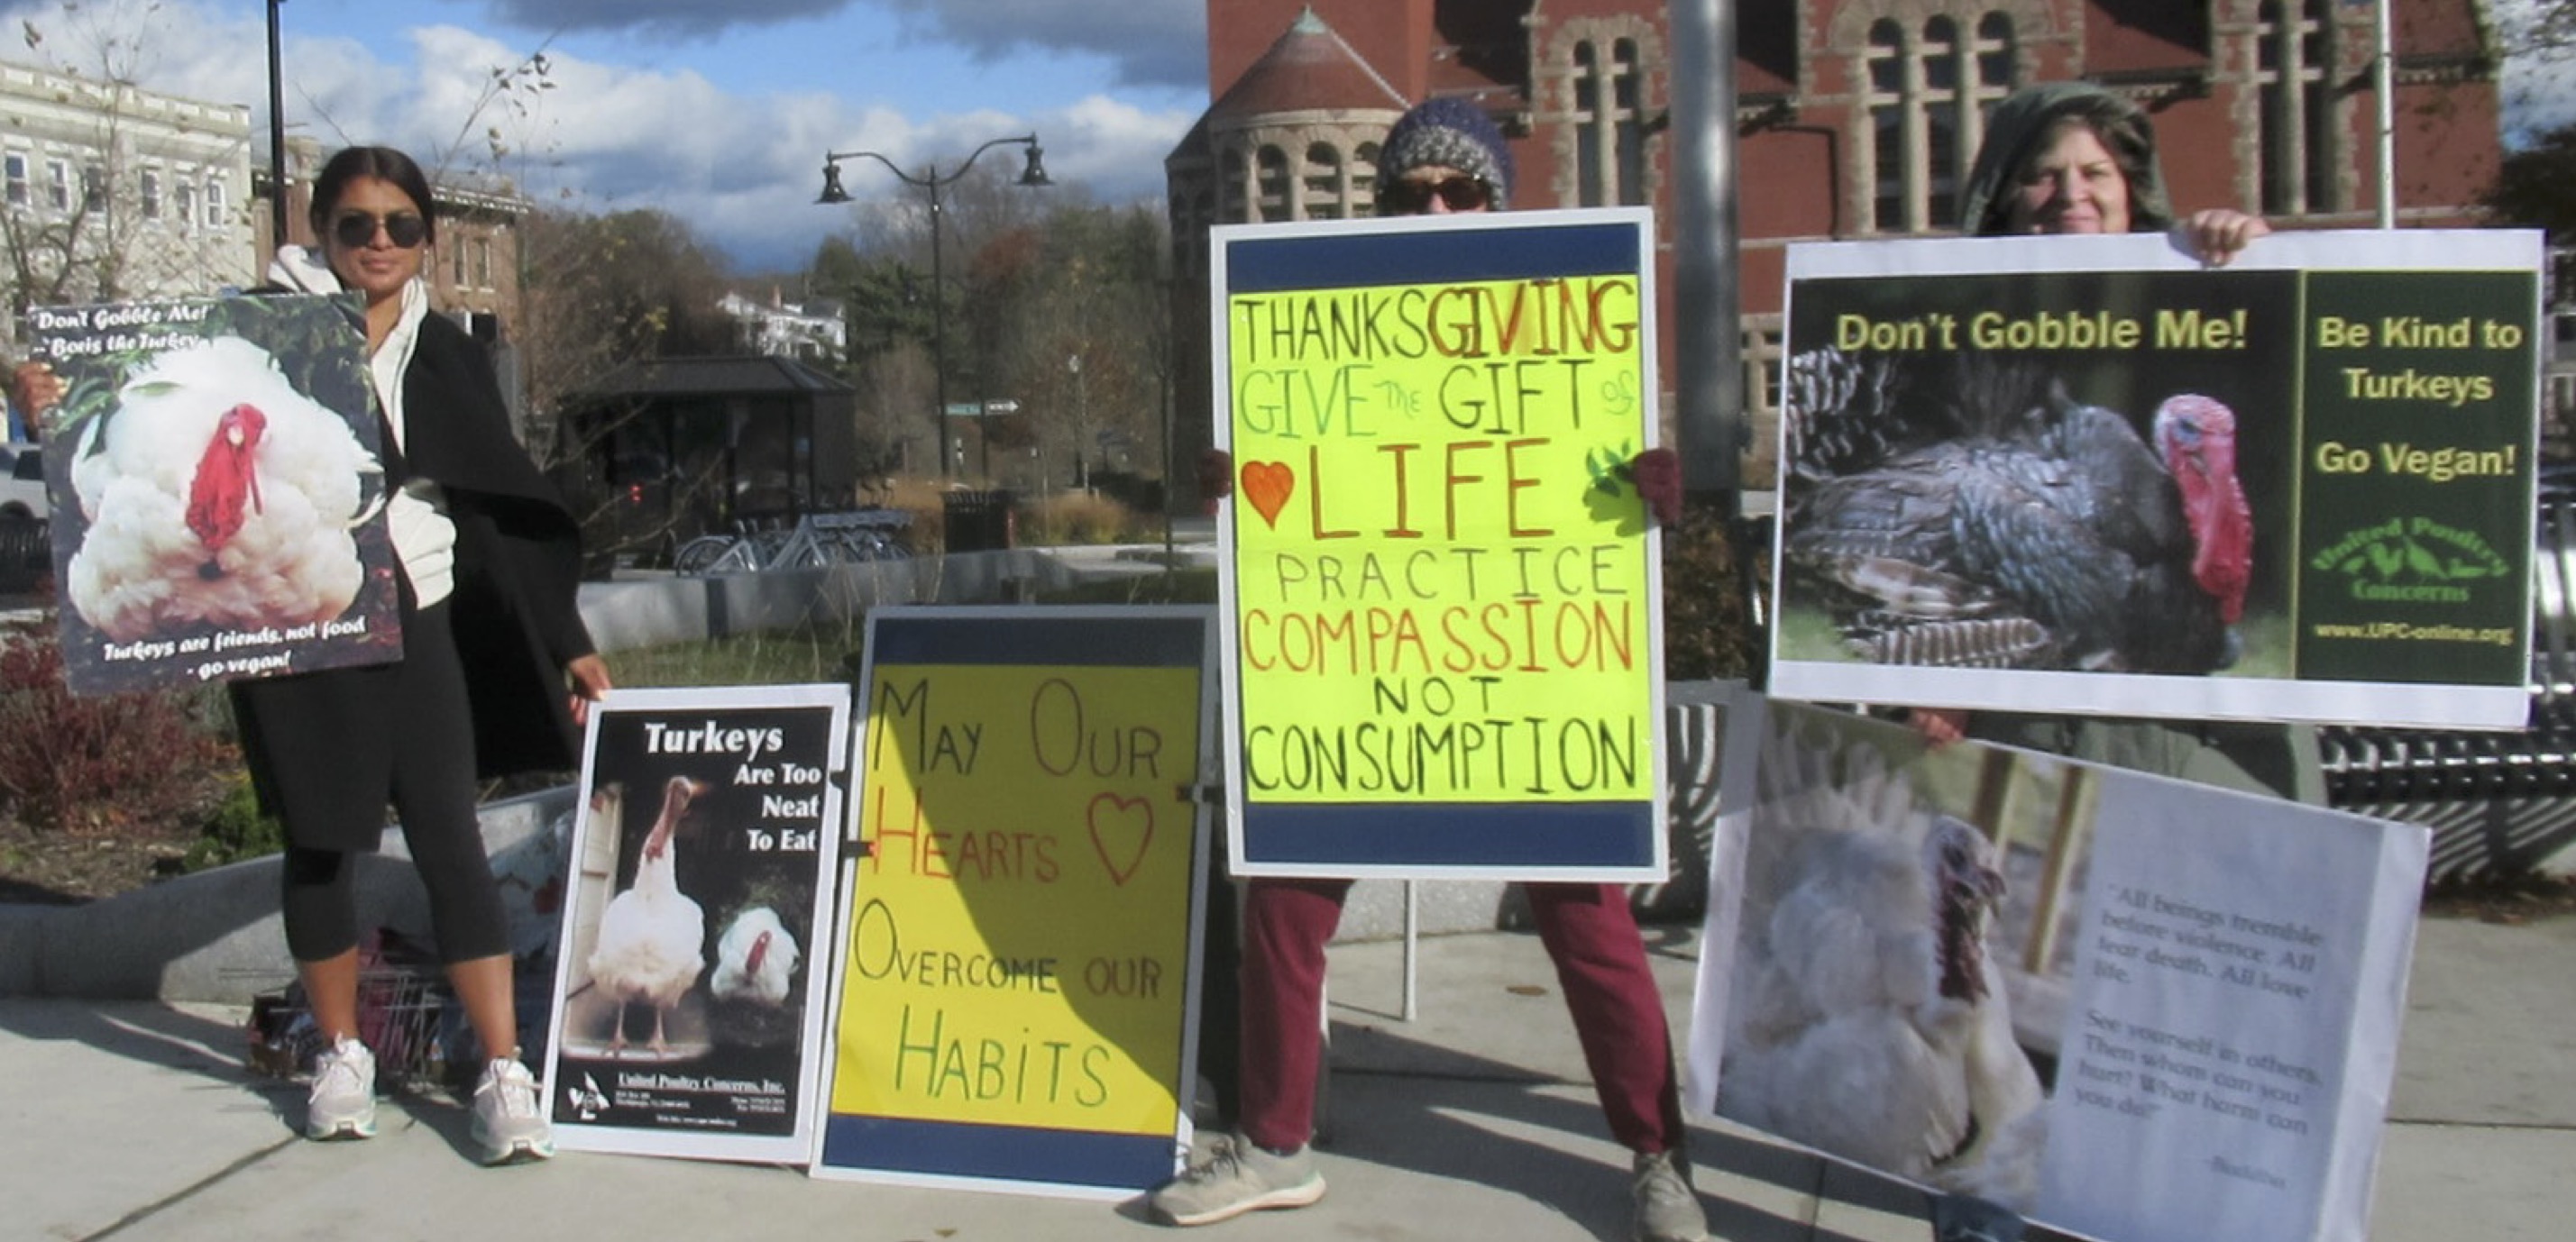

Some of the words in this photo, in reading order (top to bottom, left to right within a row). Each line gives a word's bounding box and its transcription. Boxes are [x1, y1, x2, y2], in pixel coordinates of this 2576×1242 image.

[94, 306, 163, 331] Gobble
[1233, 278, 1638, 363] THANKSGIVING
[1836, 313, 1957, 352] Don't
[1970, 310, 2141, 351] Gobble
[2155, 308, 2249, 350] Me!
[2317, 316, 2371, 348] Be
[2382, 316, 2471, 349] Kind
[2483, 319, 2523, 350] to
[106, 333, 137, 352] the
[1239, 364, 1378, 438] GIVE
[1438, 359, 1595, 435] GIFT
[2342, 367, 2495, 408] Turkeys
[2316, 441, 2372, 474] Go
[2380, 442, 2517, 482] Vegan!
[1308, 437, 1554, 541] LIFE
[2310, 516, 2403, 571] United
[2410, 516, 2510, 578] Poultry
[1275, 543, 1627, 601] PRACTICE
[2351, 577, 2471, 602] Concerns
[104, 641, 175, 662] Turkeys
[179, 636, 209, 653] are
[286, 621, 316, 641] not
[321, 615, 367, 639] food
[1244, 598, 1633, 675] COMPASSION
[2314, 621, 2515, 646] www.UPC-online.org
[198, 662, 225, 680] go
[226, 650, 292, 674] vegan!
[1373, 676, 1503, 716] NOT
[644, 720, 784, 762] Turkeys
[1246, 715, 1636, 796] CONSUMPTION
[734, 763, 775, 785] Are
[781, 763, 821, 784] Too
[762, 794, 820, 817] Neat
[747, 828, 774, 851] To
[780, 828, 816, 851] Eat
[2101, 909, 2168, 939] before
[2279, 951, 2316, 973] All
[2153, 894, 2225, 929] beings
[2232, 913, 2325, 946] tremble
[854, 898, 1059, 994] OVERCOME
[2099, 936, 2141, 958] fear
[2220, 964, 2256, 986] All
[2260, 972, 2310, 999] love
[2086, 1008, 2122, 1033] See
[2127, 1025, 2214, 1056] yourself
[2218, 1046, 2241, 1064] in
[2085, 1033, 2135, 1062] Then
[2141, 1053, 2207, 1081] whom
[2213, 1072, 2252, 1092] can
[2259, 1084, 2301, 1107] you
[2075, 1087, 2113, 1110] you
[2141, 1073, 2196, 1105] What
[2203, 1091, 2260, 1122] harm
[2266, 1113, 2309, 1137] can
